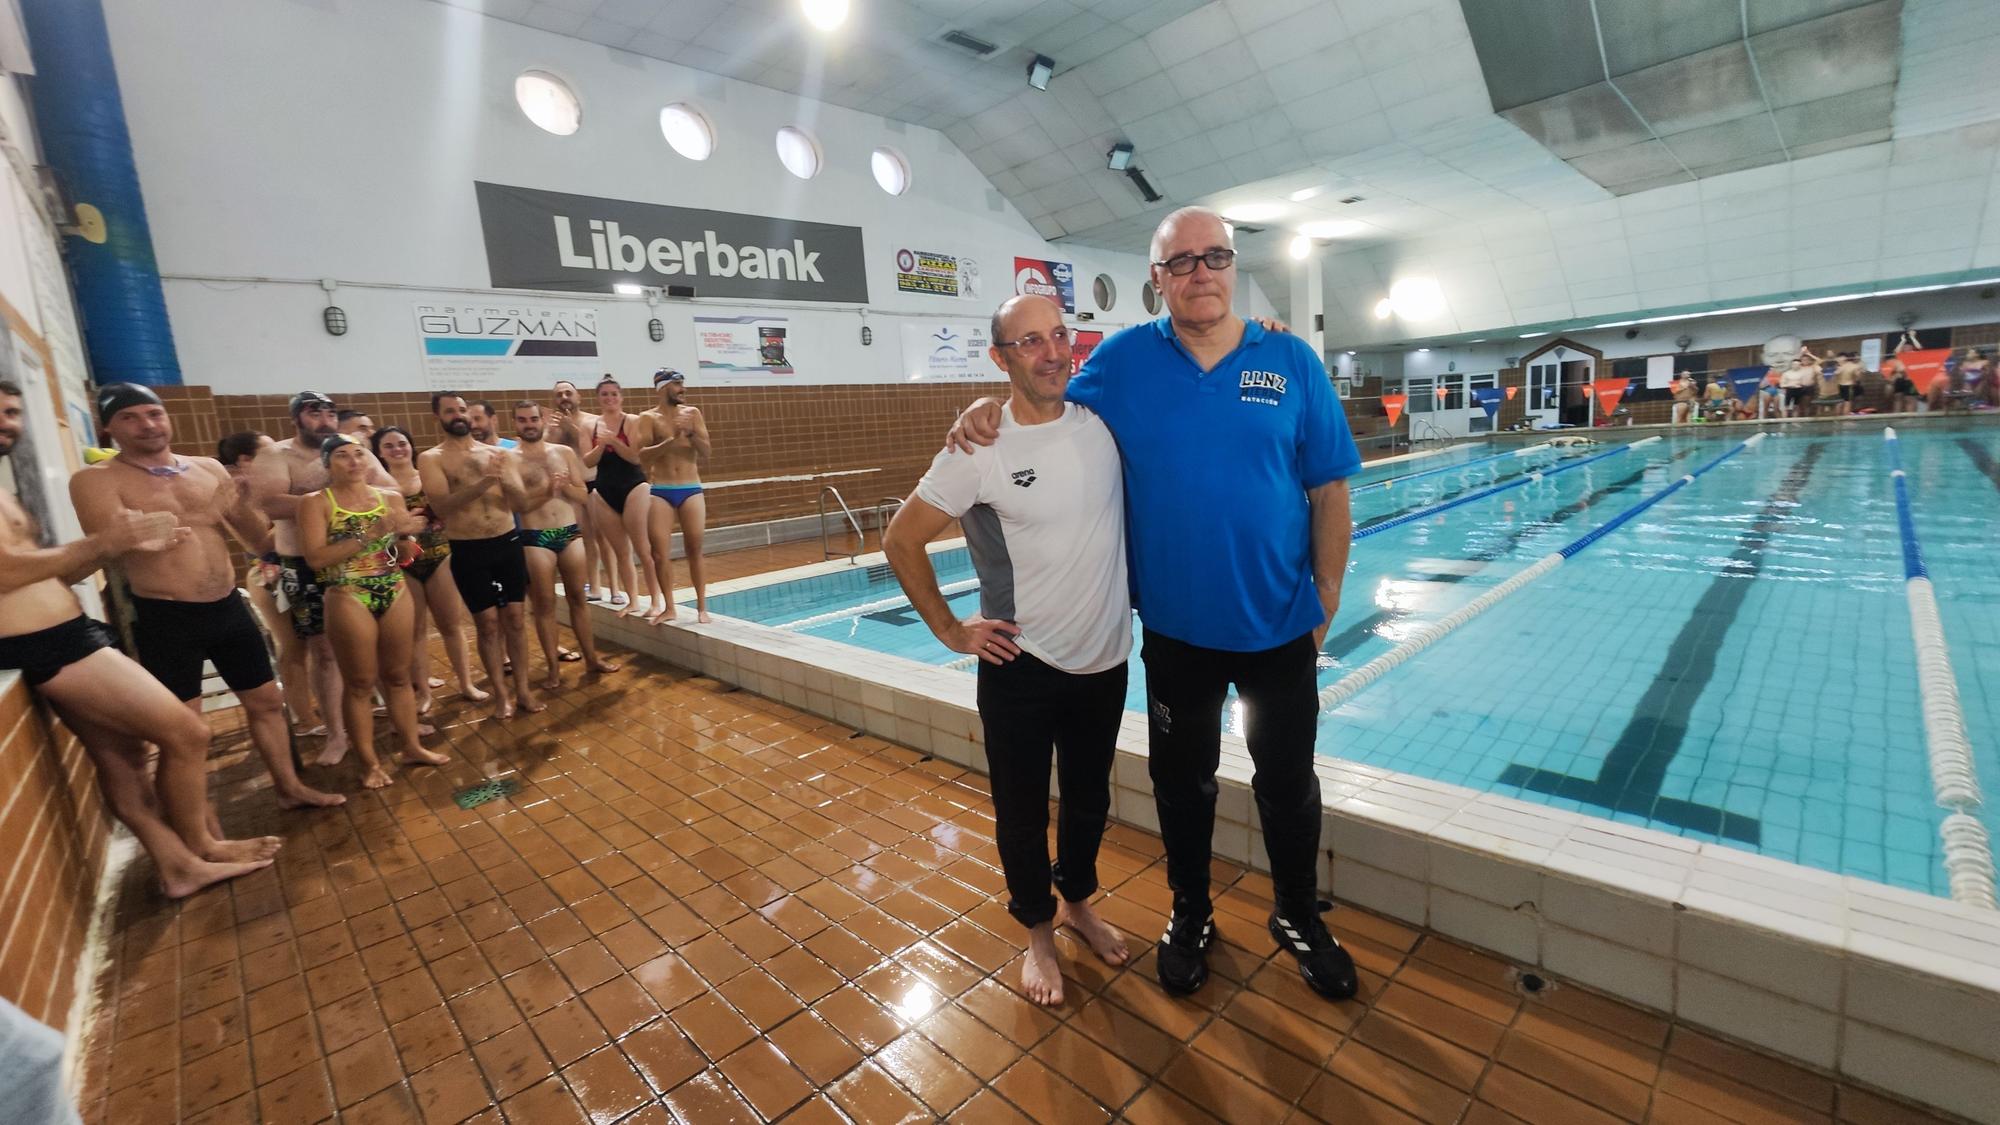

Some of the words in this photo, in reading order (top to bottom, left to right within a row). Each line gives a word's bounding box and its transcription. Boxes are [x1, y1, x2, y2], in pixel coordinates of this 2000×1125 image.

[553, 215, 824, 283] Liberbank
[420, 315, 597, 337] GUZMAN
[1239, 370, 1287, 394] LLNZ
[1011, 468, 1035, 479] arena
